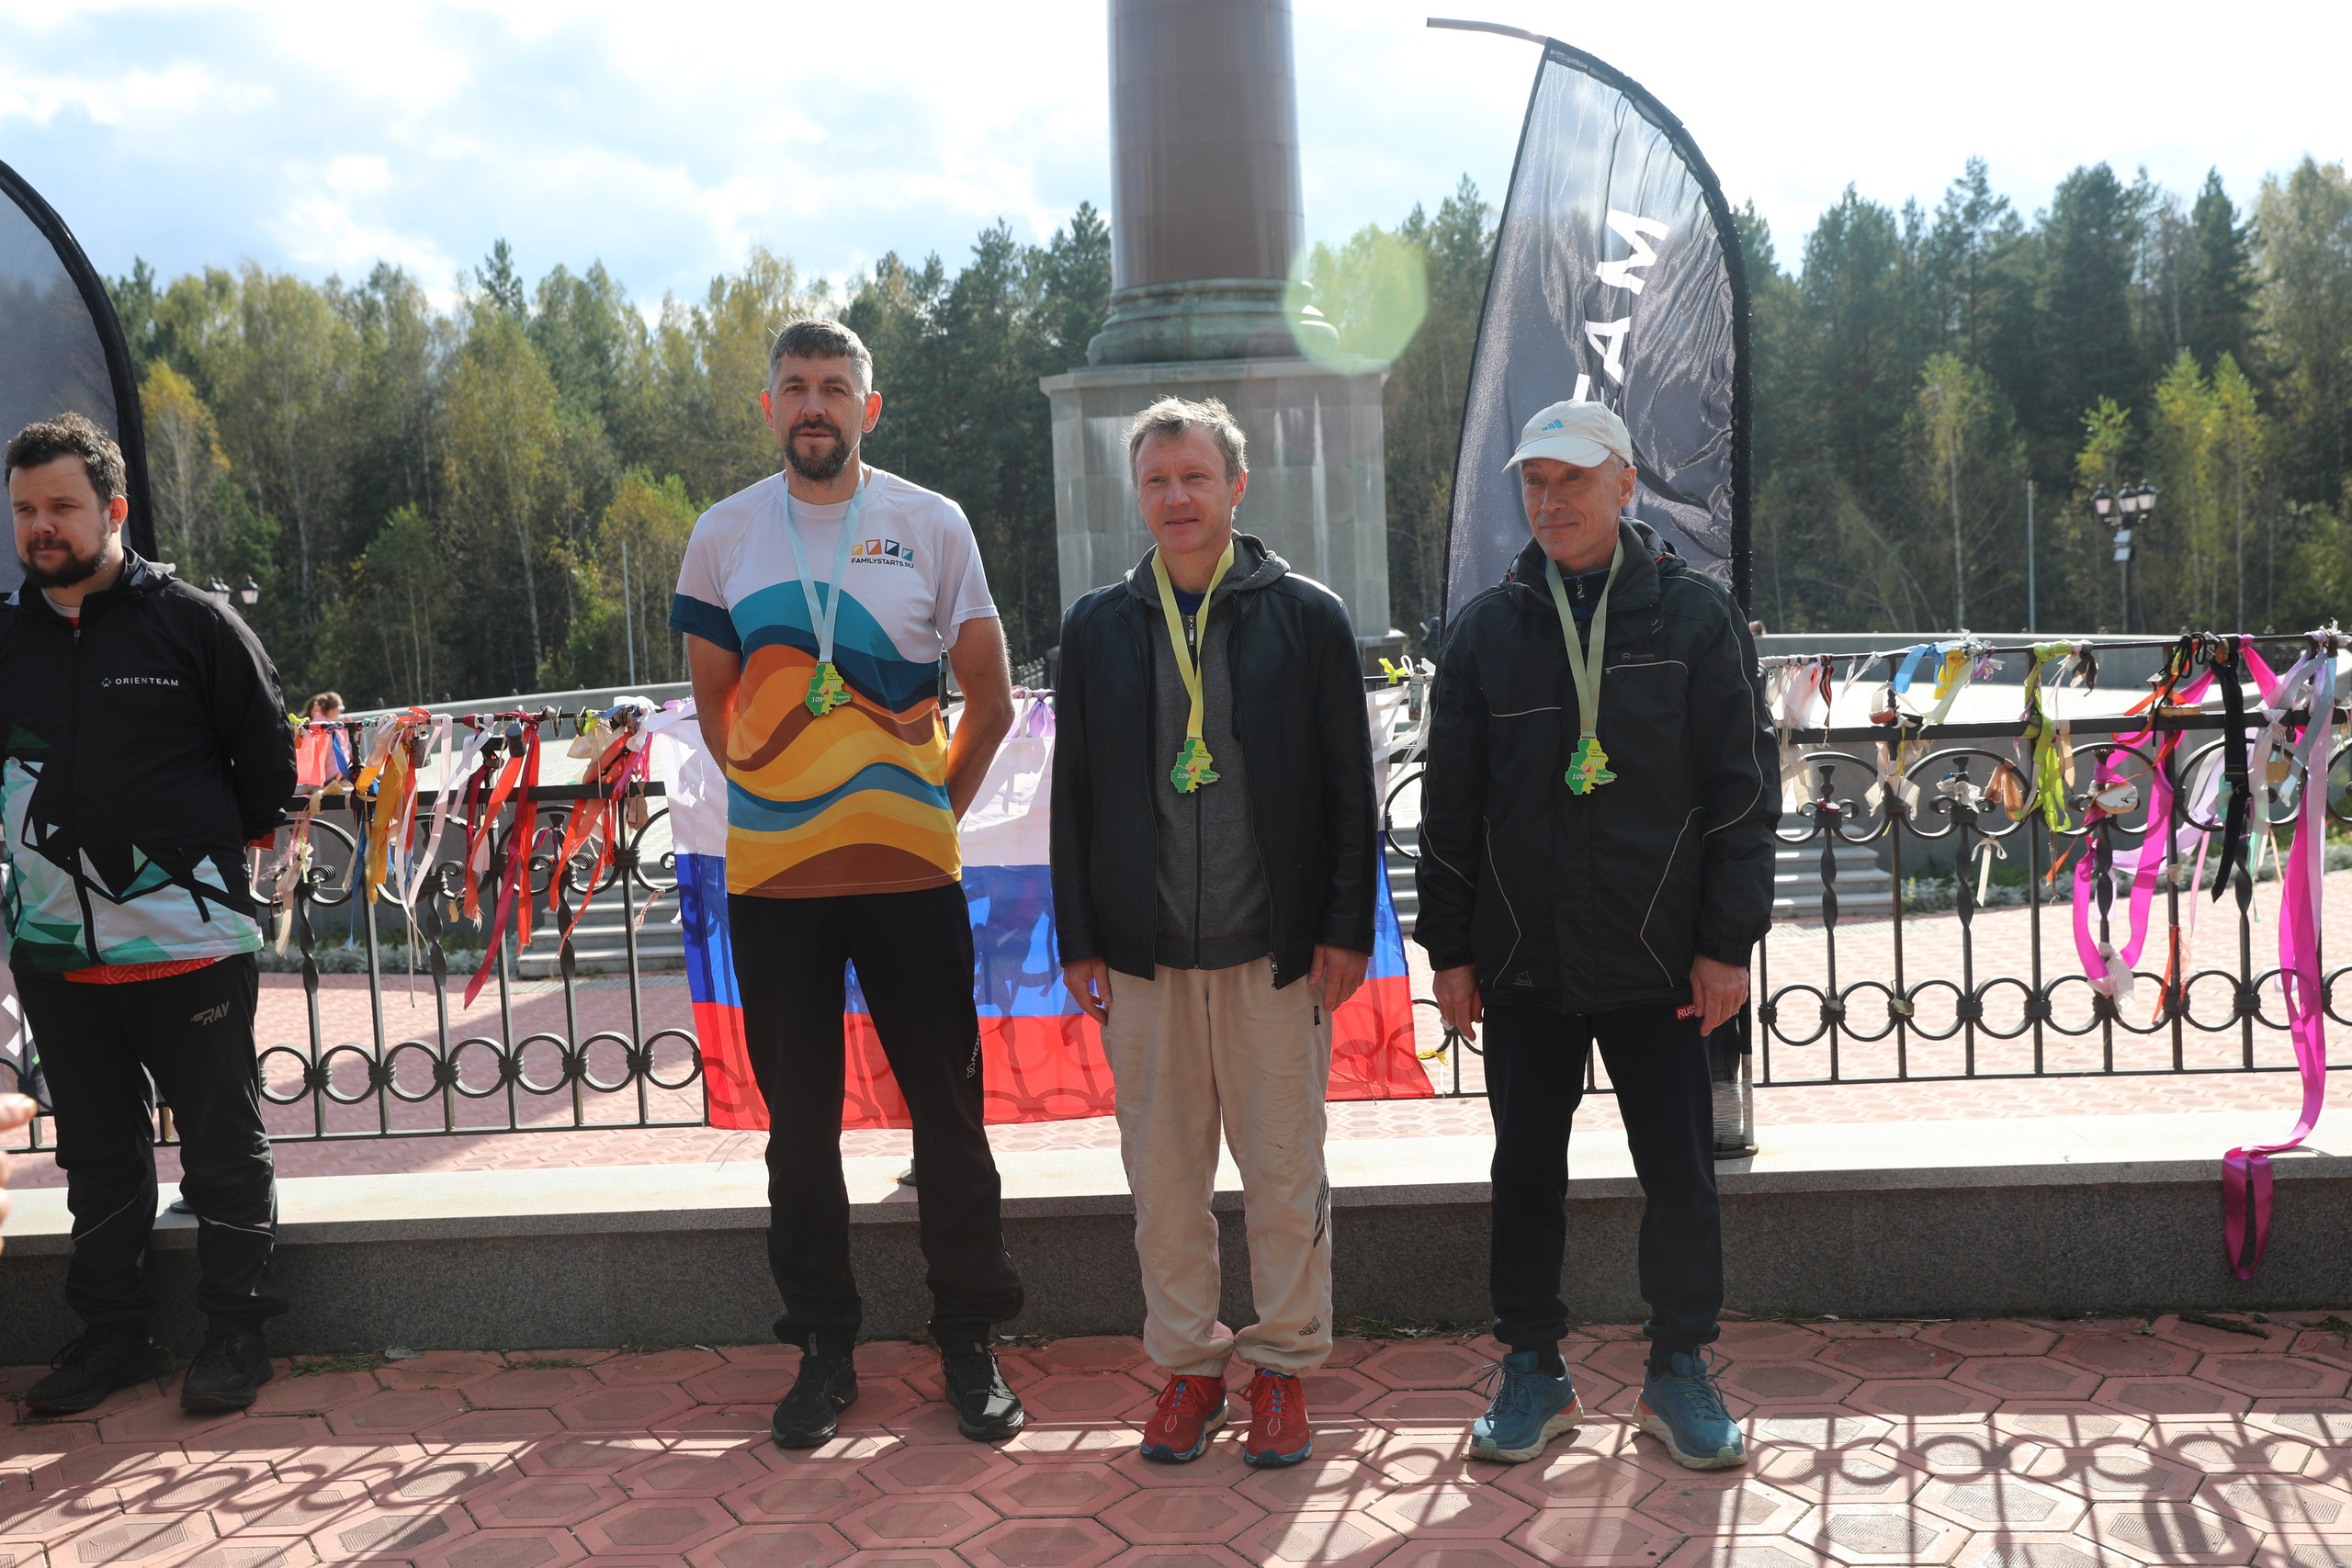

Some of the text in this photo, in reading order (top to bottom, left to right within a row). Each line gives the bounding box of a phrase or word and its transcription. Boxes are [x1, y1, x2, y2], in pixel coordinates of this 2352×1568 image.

[851, 558, 914, 569] FAMILYSTARTS.RU
[115, 677, 179, 686] ORIENTEAM
[191, 1000, 230, 1026] RAY
